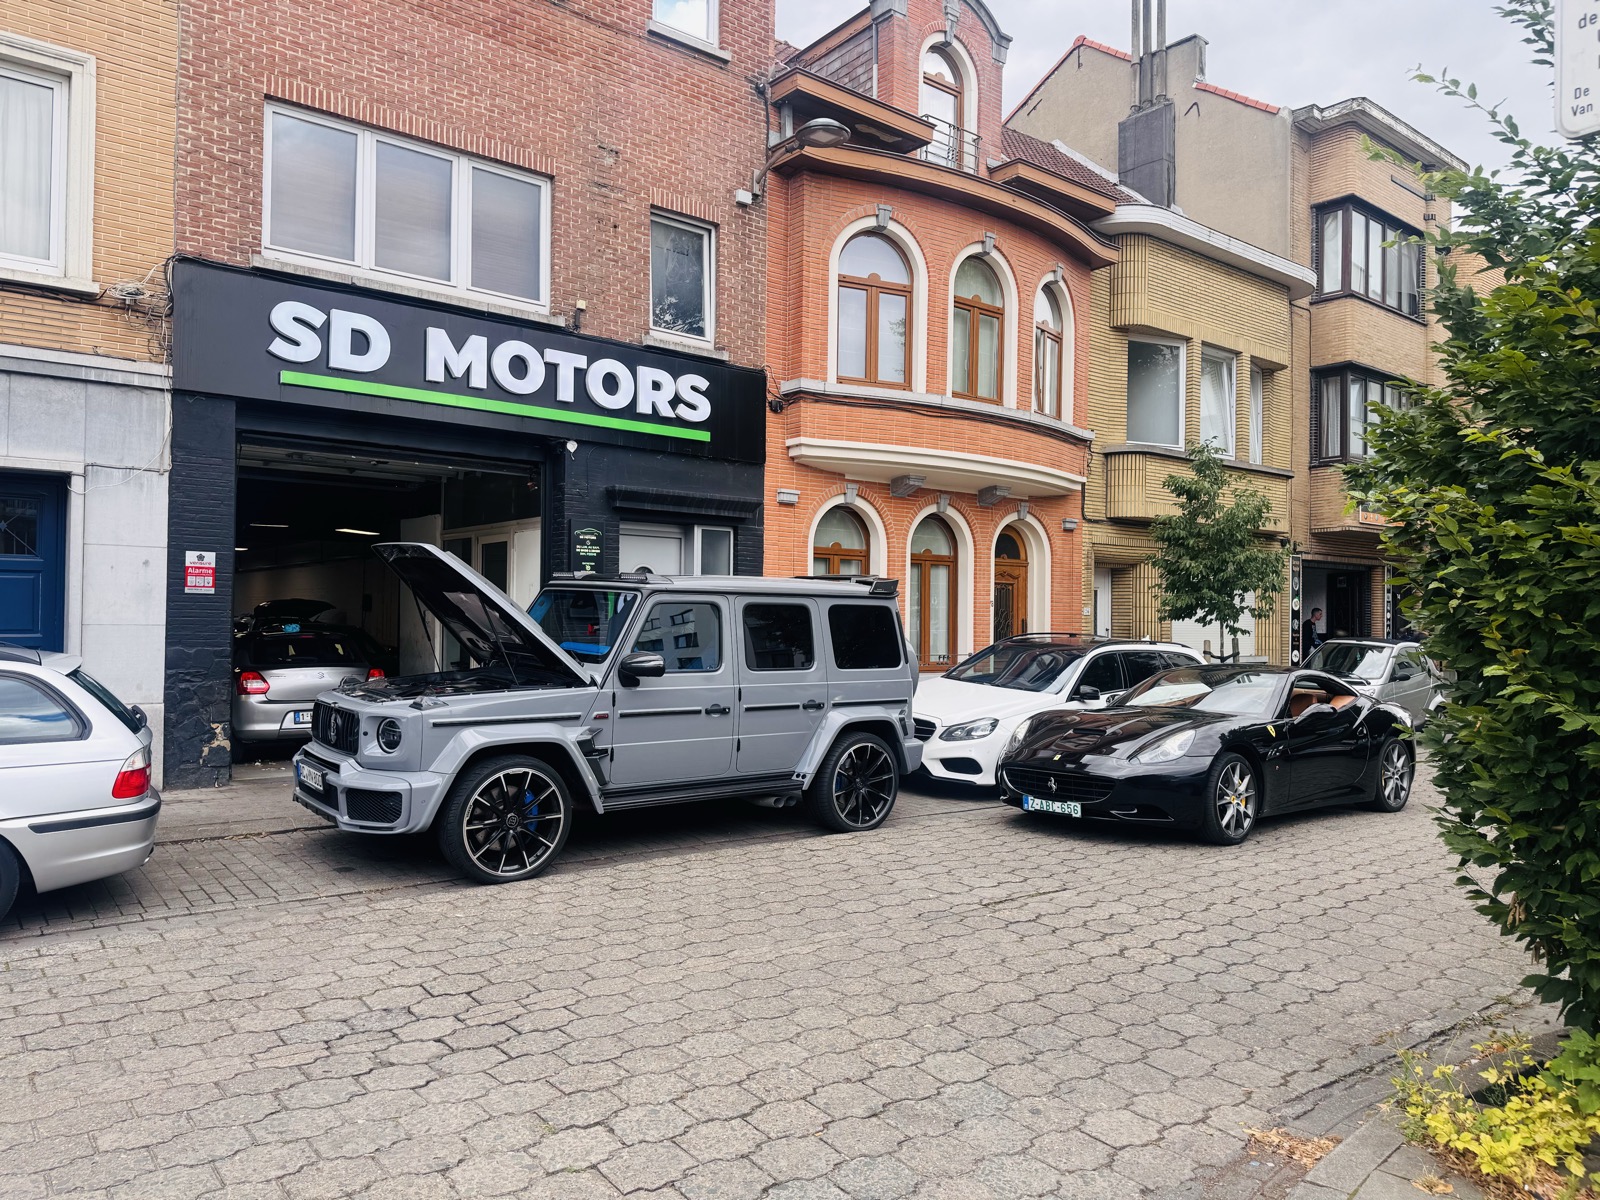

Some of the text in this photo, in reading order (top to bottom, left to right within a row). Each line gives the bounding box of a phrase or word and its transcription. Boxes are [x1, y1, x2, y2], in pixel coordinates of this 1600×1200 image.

[1578, 13, 1598, 29] de
[1574, 87, 1590, 100] De
[1571, 103, 1593, 116] Van
[266, 300, 712, 423] SD MOTORS
[1030, 798, 1079, 815] Z-ABC-656
